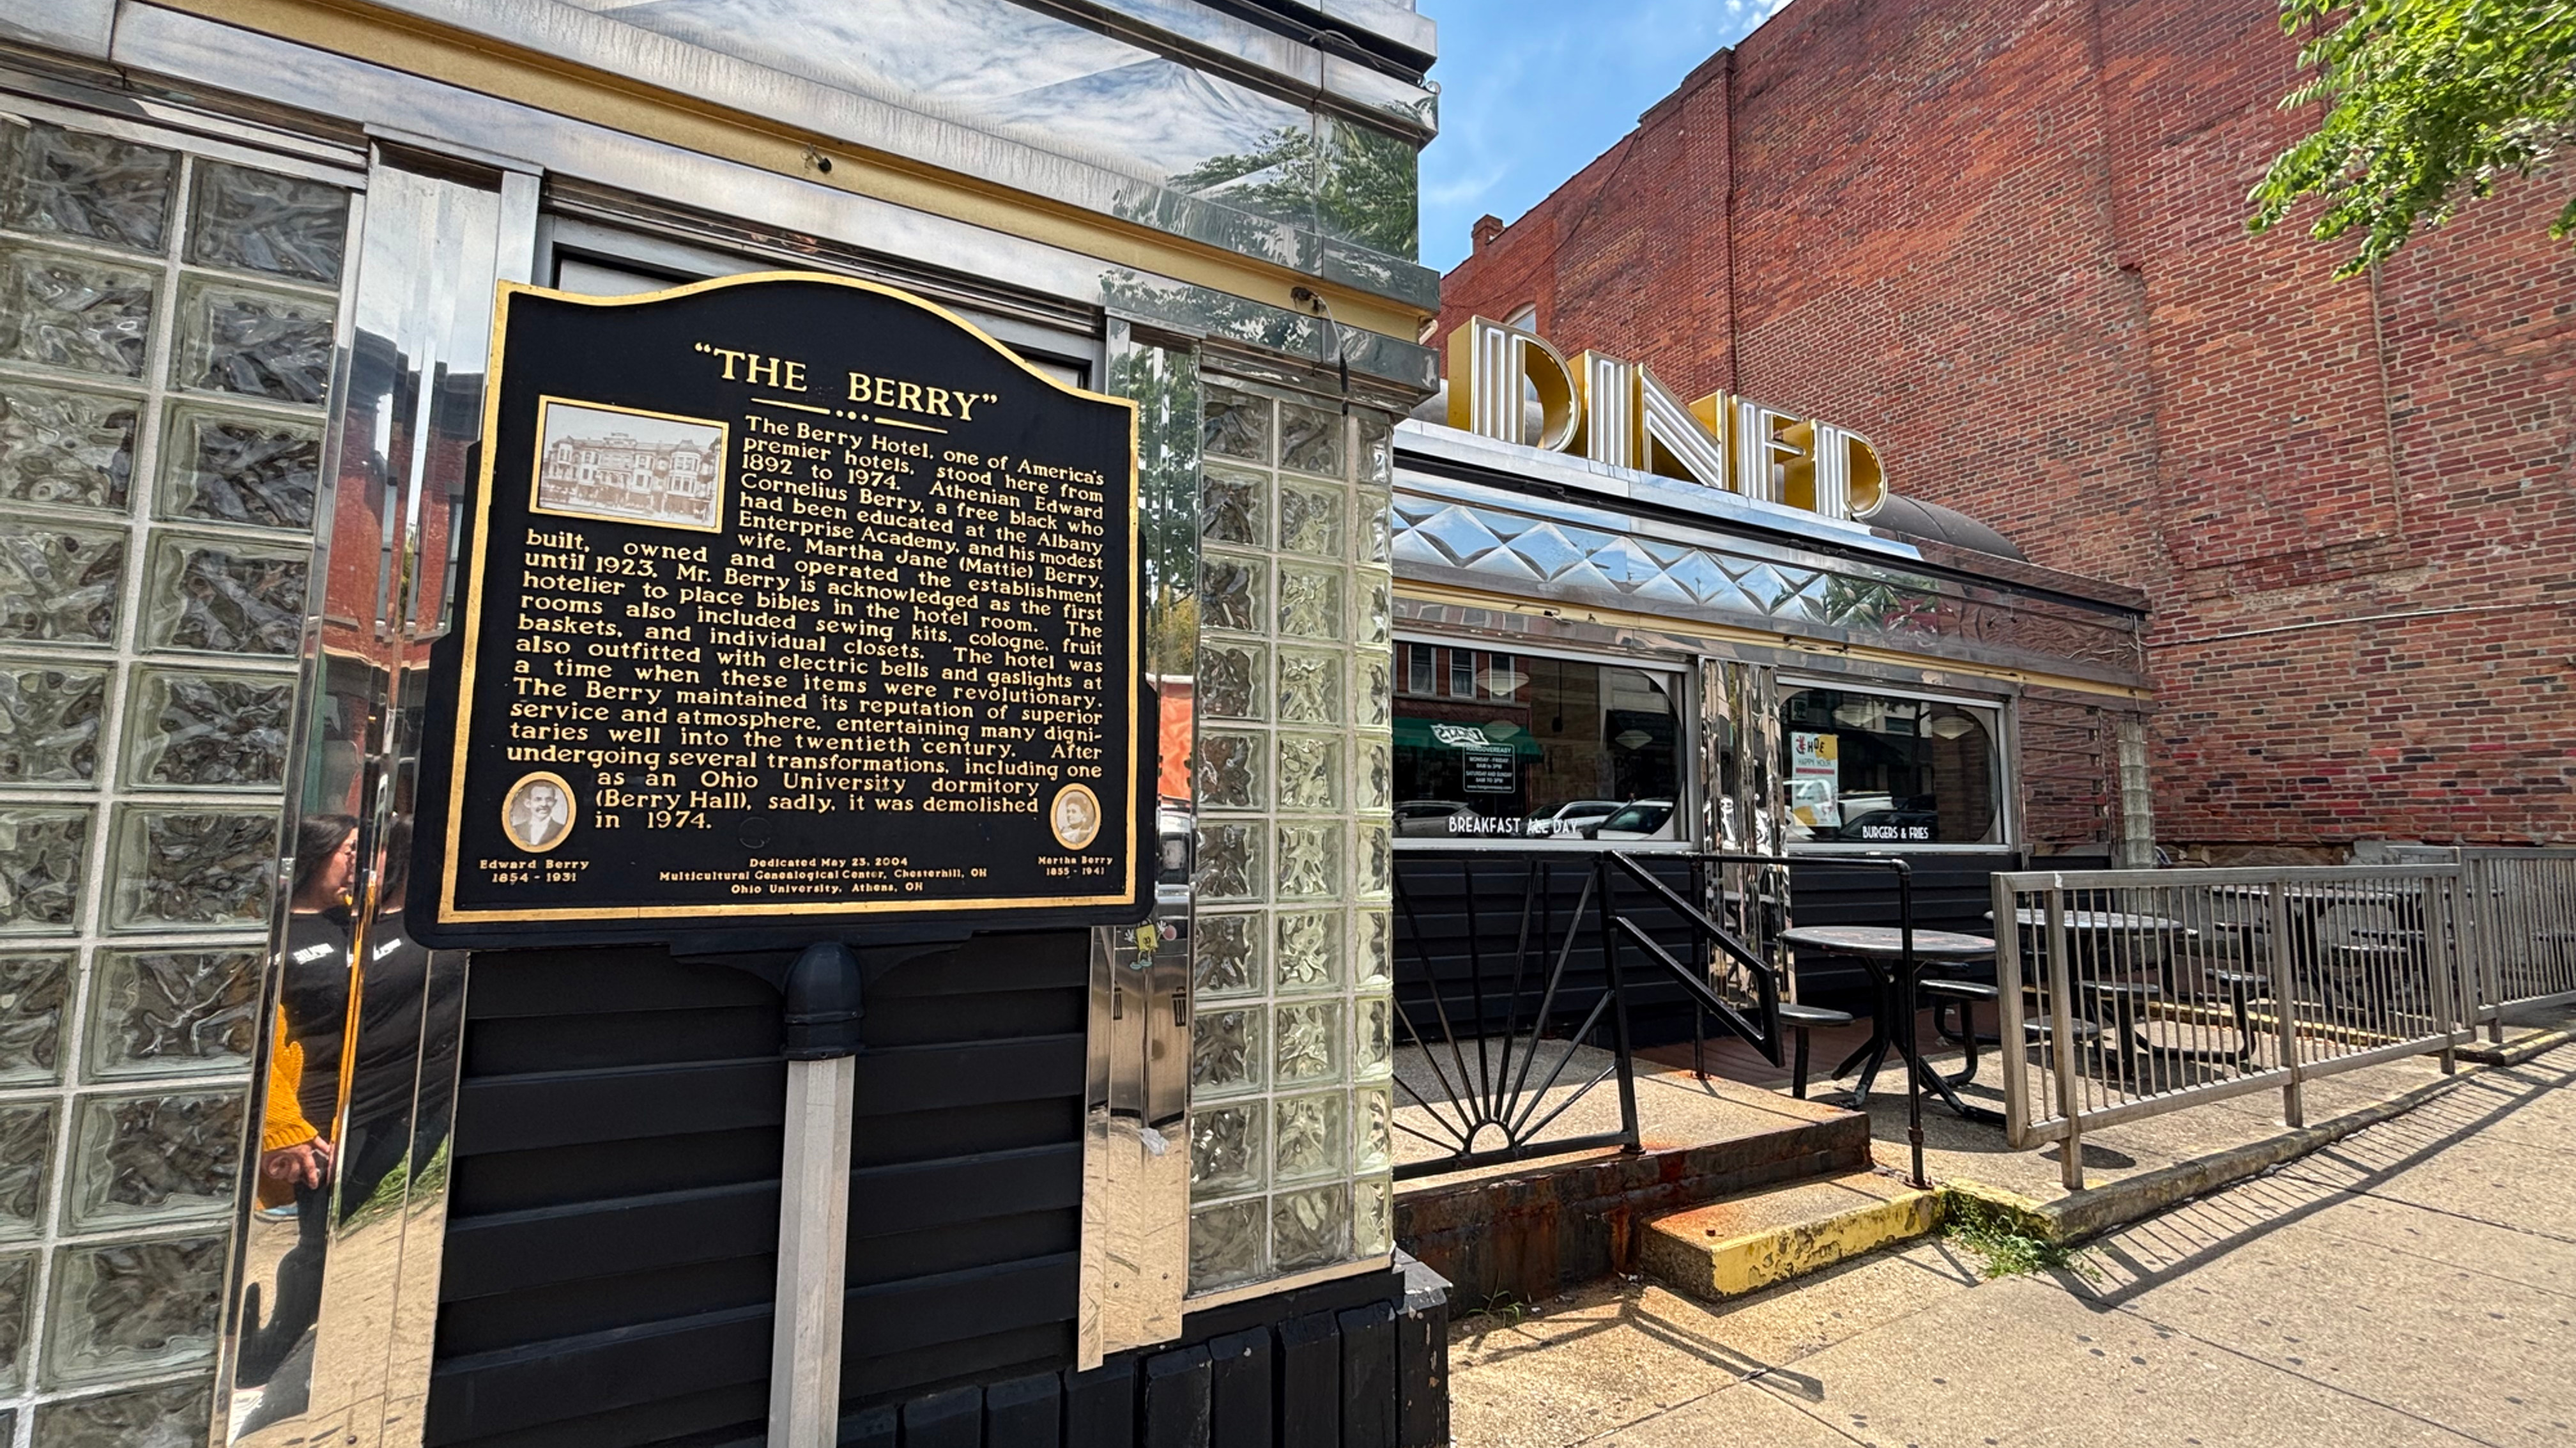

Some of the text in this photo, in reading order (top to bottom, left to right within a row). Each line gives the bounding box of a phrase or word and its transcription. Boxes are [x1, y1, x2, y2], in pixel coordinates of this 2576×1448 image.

[745, 415, 1104, 486] The Berry Hotel, one of America's
[742, 454, 1103, 520] 1892 to 1974. Athenian Edward
[743, 437, 1103, 503] premier hotels, stood here from
[740, 473, 1104, 536] Cornelius Berry, a free black who
[739, 509, 1103, 570] Enterprise Academy, and his modest
[526, 528, 1103, 605] built, owned and operated the establishment
[738, 532, 1104, 589] wife, Martha Jane (Mattie) Berry,
[525, 552, 1103, 621] until 1923. Mr. Berry is acknowledged as the first
[518, 613, 1103, 673] baskets, and individual closets. The hotel was
[521, 595, 1102, 655] rooms also included sewing kits, cologne, fruit
[512, 676, 1103, 725] The Berry maintained its reputation of superior
[514, 658, 1102, 710] a time when these items were revolutionary.
[510, 722, 1102, 760] taries well into the twentieth century. After
[507, 744, 1102, 781] undergoing several transformations, including one
[595, 789, 1038, 813] (Berry Hall), sadly, it was demolished
[597, 770, 1039, 797] as an Ohio University dormitory
[595, 810, 712, 829] in 1974.
[1448, 816, 1521, 833] BREAKFAST
[1552, 819, 1578, 834] DAY
[1862, 825, 1929, 839] BURGERS & FRIES
[480, 859, 589, 870] Edward Berry
[492, 872, 528, 883] 1854
[546, 872, 576, 882] 1931
[659, 871, 749, 881] Multicultural
[755, 870, 839, 882] Genealogical
[970, 868, 987, 877] OH
[749, 858, 816, 868] Dedicated
[821, 858, 846, 868] May
[875, 857, 908, 866] 2004
[1038, 856, 1113, 865] Martha Berry
[1046, 866, 1070, 876] 1855
[1082, 866, 1105, 875] 1941
[731, 884, 762, 894] Ohio
[905, 882, 923, 891] OH
